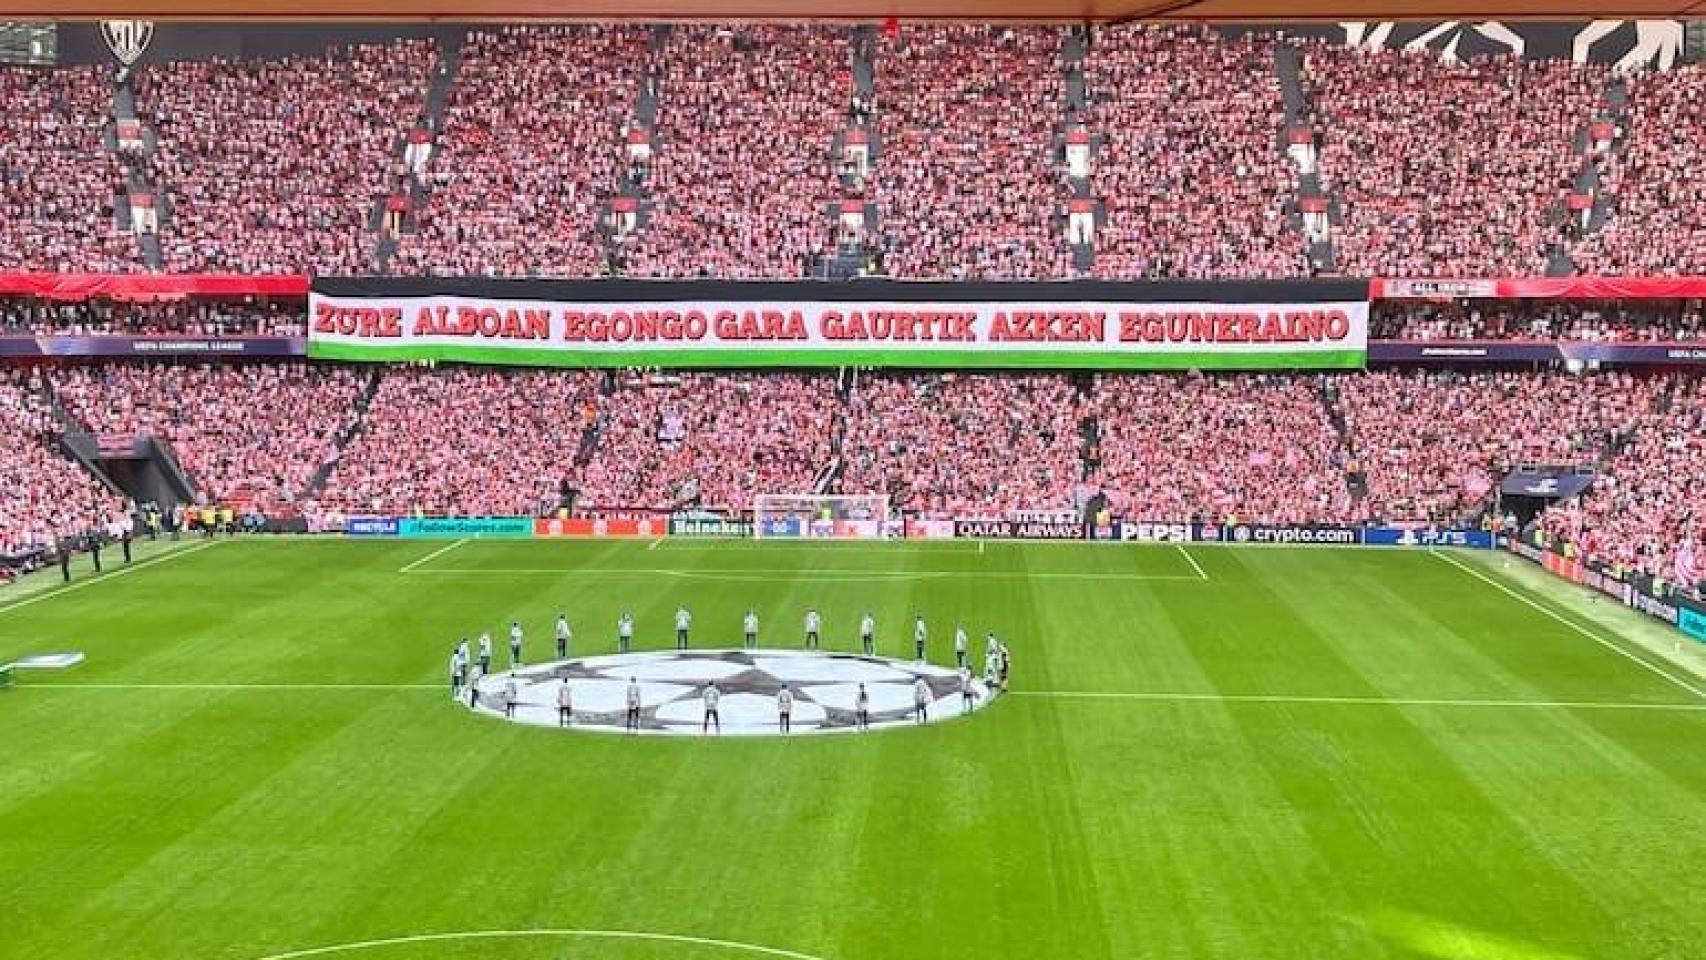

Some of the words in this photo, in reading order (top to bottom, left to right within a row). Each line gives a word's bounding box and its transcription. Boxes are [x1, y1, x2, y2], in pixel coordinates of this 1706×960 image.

[314, 303, 402, 338] ZURE
[413, 306, 551, 340] ALBOAN
[563, 309, 708, 343] EGONGO
[713, 311, 808, 340] GARA
[820, 310, 977, 340] GAURTIK
[988, 311, 1106, 341] AZKEN
[1118, 311, 1350, 343] EGUNERAINO
[674, 519, 751, 534] Heineken
[959, 521, 1011, 536] QATAR
[1016, 522, 1082, 538] AIRWAYS
[1121, 522, 1192, 540] PEPSI
[1254, 526, 1355, 545] crypto.com
